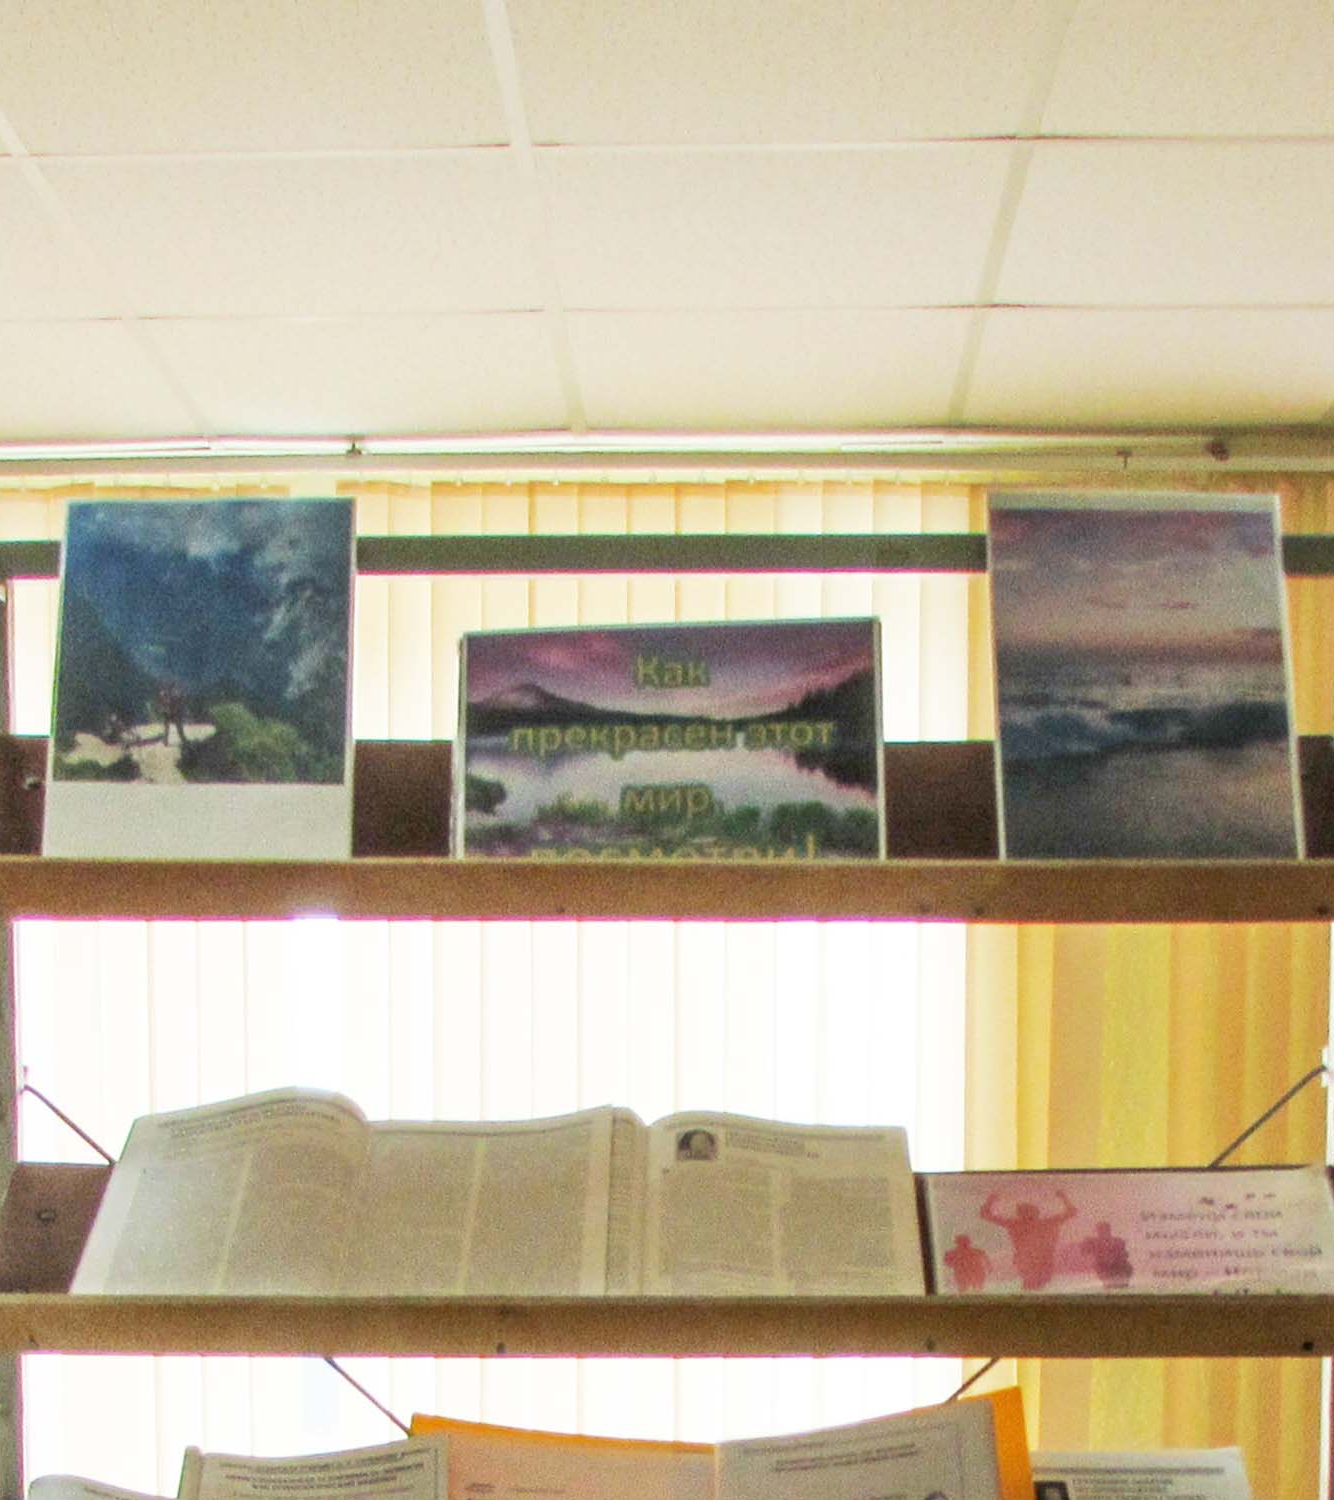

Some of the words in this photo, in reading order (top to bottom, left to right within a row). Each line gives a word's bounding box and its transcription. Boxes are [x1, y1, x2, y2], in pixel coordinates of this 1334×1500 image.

[635, 655, 708, 686] Как
[511, 723, 733, 759] прекрасен
[751, 720, 835, 751] этот
[626, 789, 710, 819] мир
